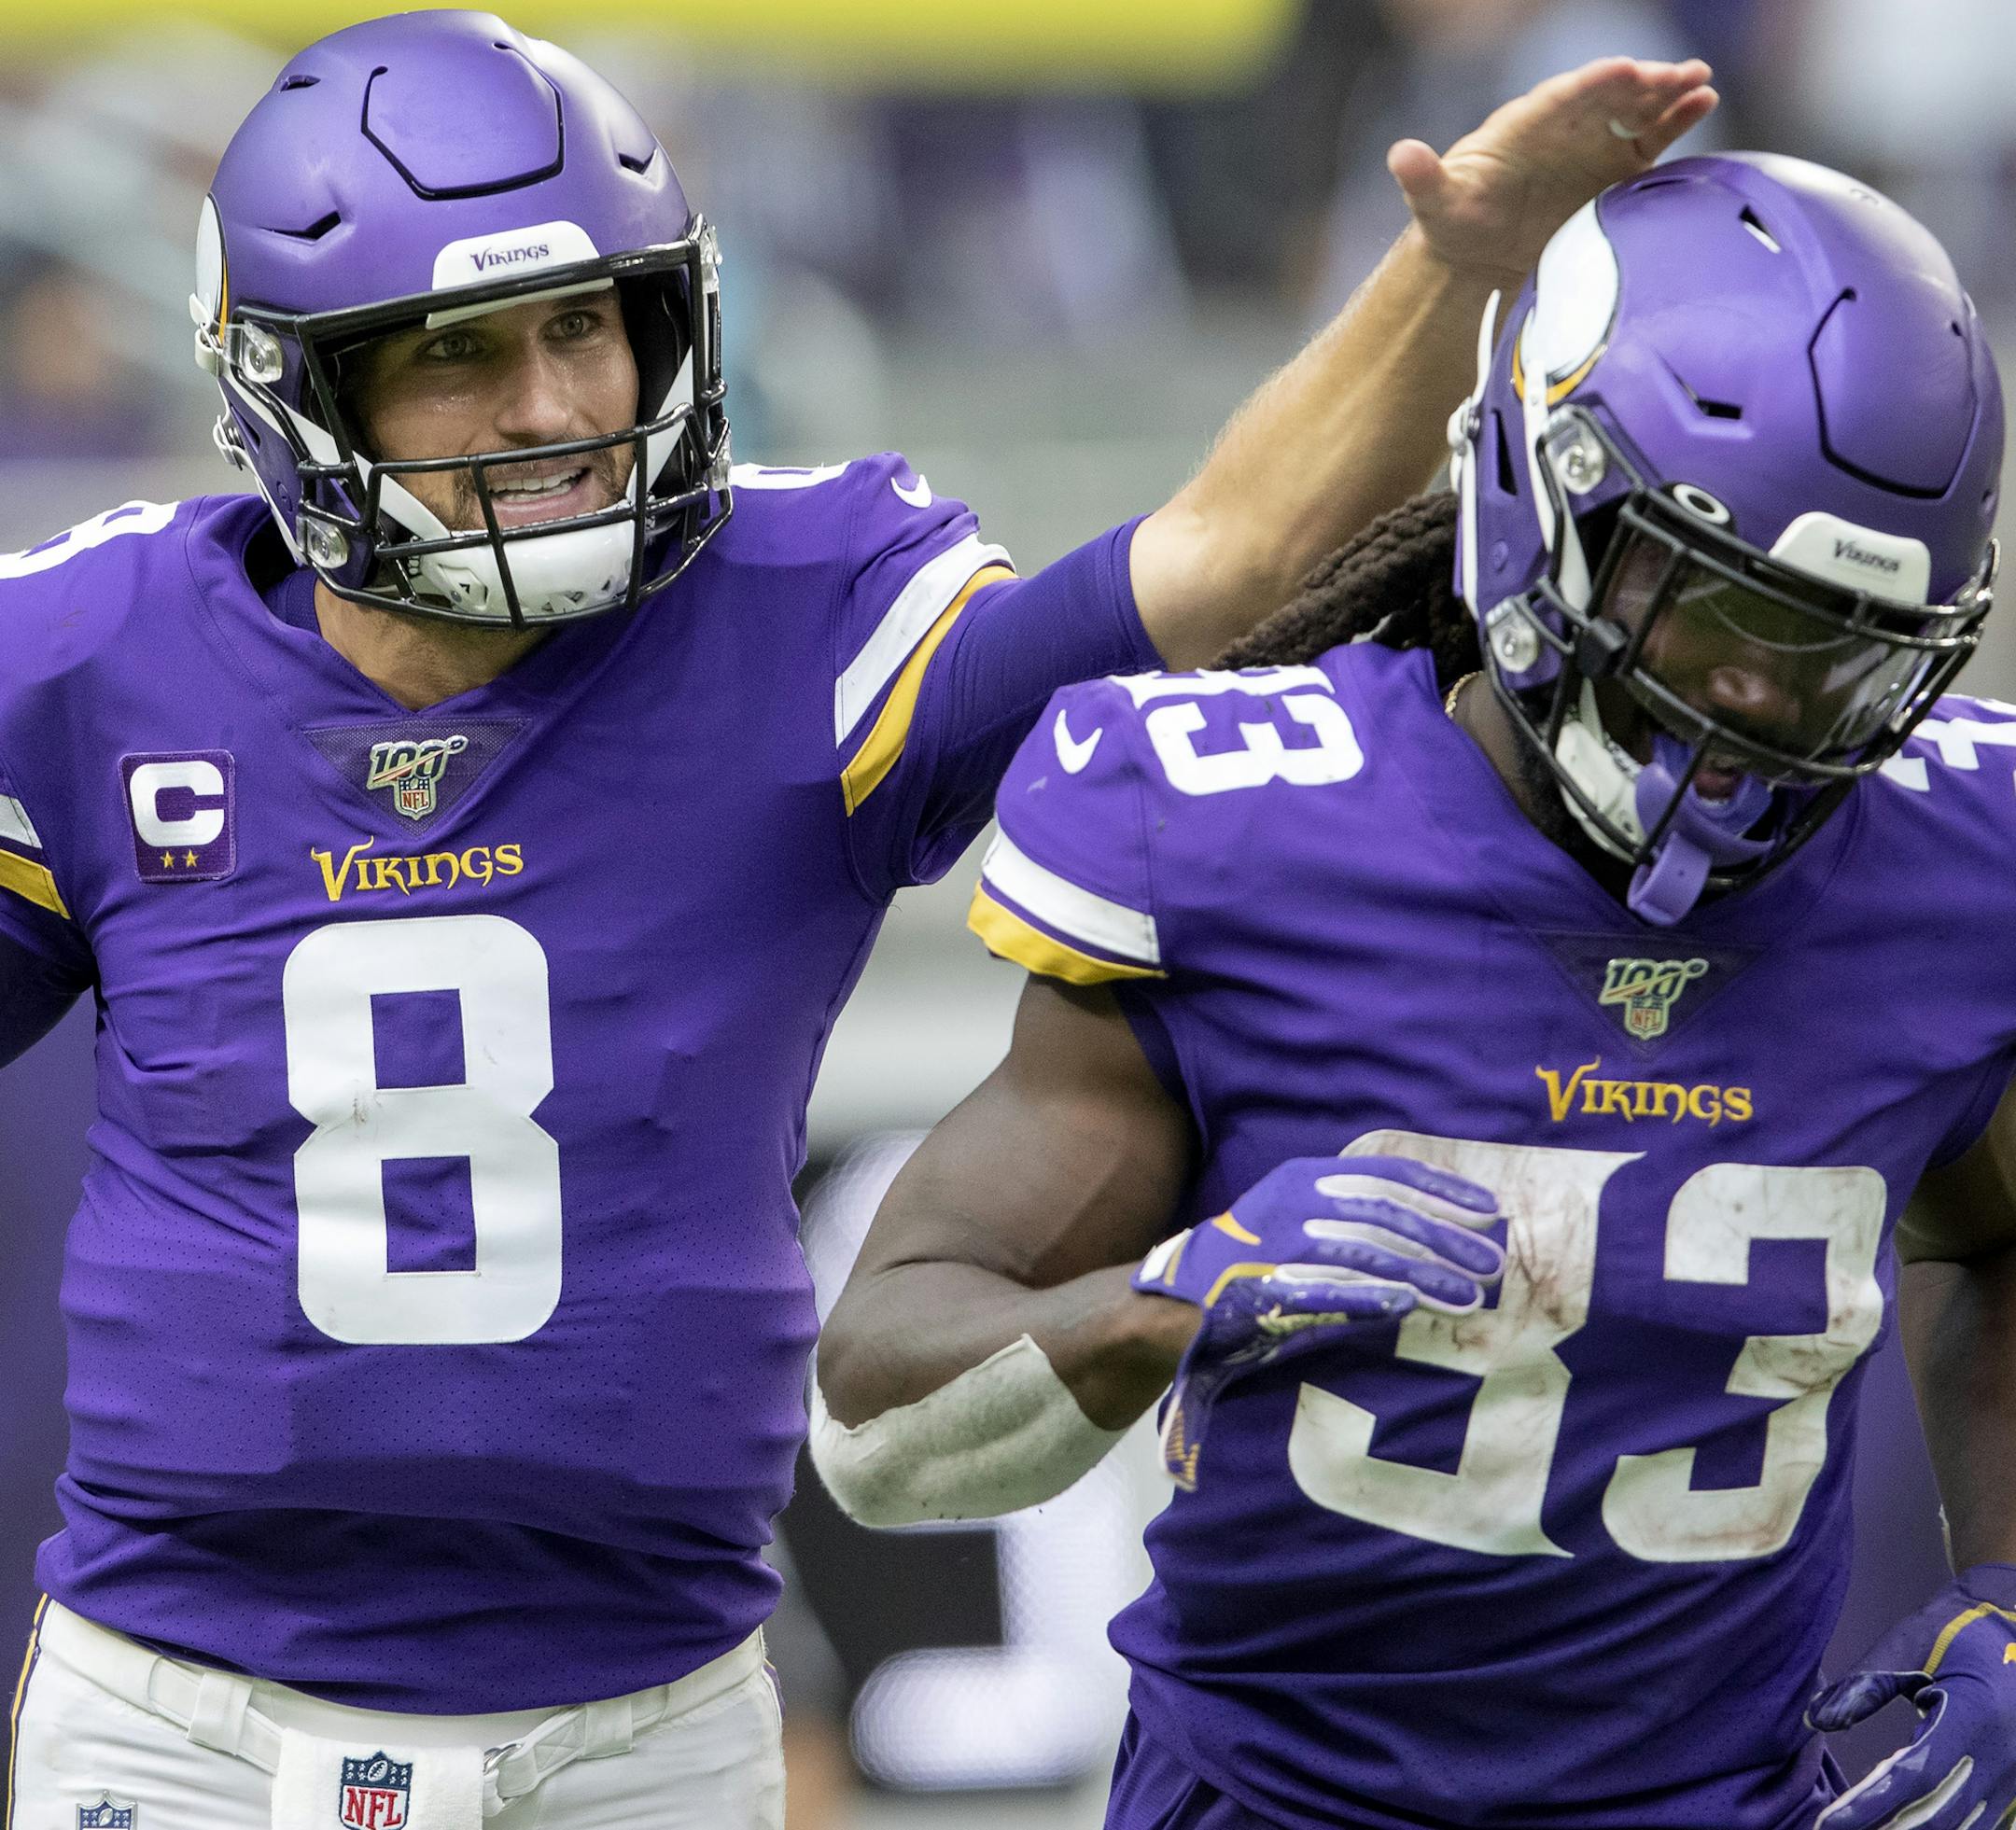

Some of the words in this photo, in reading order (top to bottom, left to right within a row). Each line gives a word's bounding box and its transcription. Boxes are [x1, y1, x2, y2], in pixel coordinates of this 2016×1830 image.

[129, 761, 225, 847] C
[402, 790, 429, 810] NFL
[283, 914, 564, 1346] 8
[1287, 1129, 1887, 1563] 33
[344, 1787, 403, 1830] NFL
